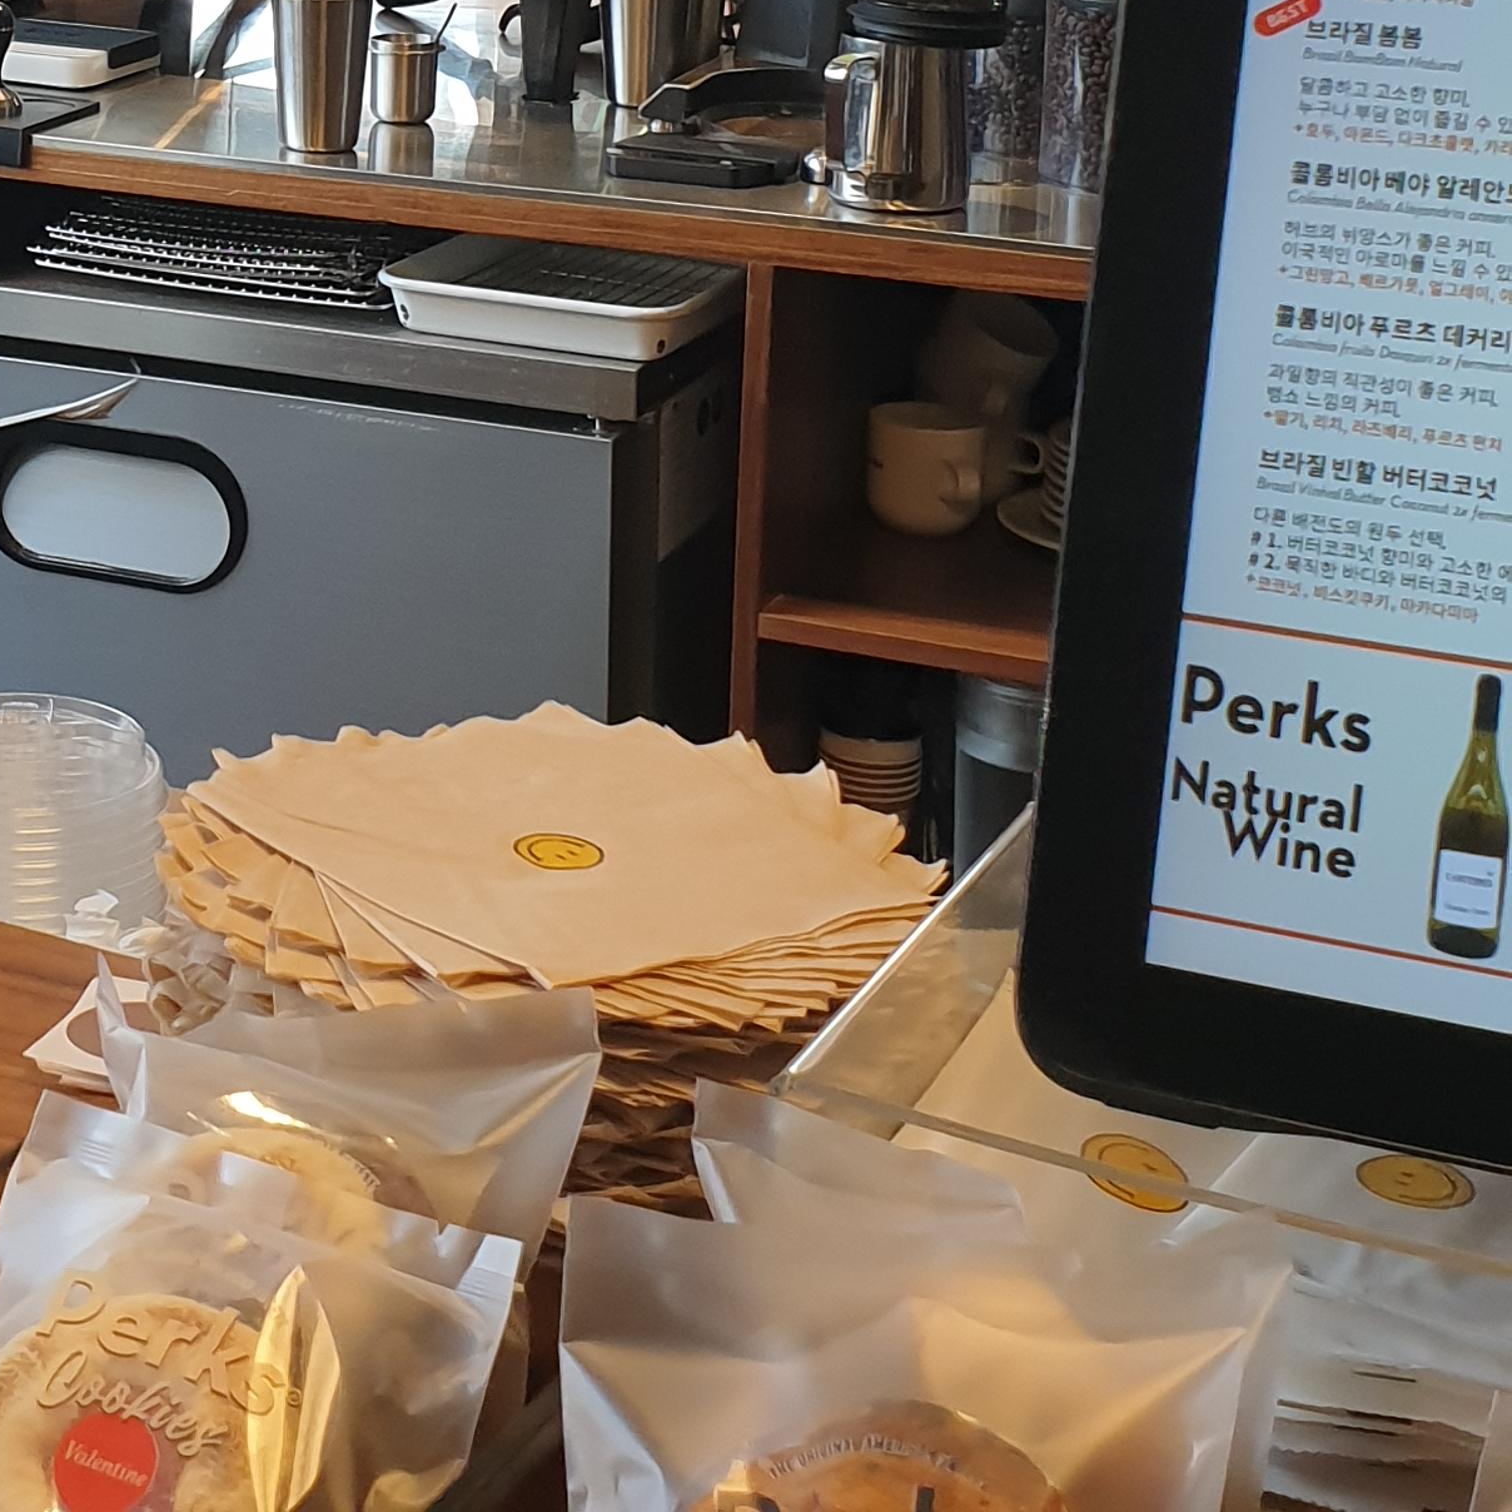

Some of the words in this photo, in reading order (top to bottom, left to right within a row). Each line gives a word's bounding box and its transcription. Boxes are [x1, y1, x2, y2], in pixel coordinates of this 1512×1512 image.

[1266, 0, 1308, 28] BEST
[1304, 20, 1373, 46] 브라질
[1291, 161, 1379, 192] 콜롬비아
[1275, 304, 1365, 336] 콜롬비아
[1258, 448, 1326, 478] 브라질
[1382, 464, 1498, 501] 버터코코넛
[1181, 663, 1372, 753] Perks
[1171, 756, 1364, 833] Natural
[1223, 809, 1356, 878] Wine
[35, 1270, 287, 1416] Perks
[37, 1350, 228, 1457] Cookies
[63, 1439, 150, 1488] Valentine
